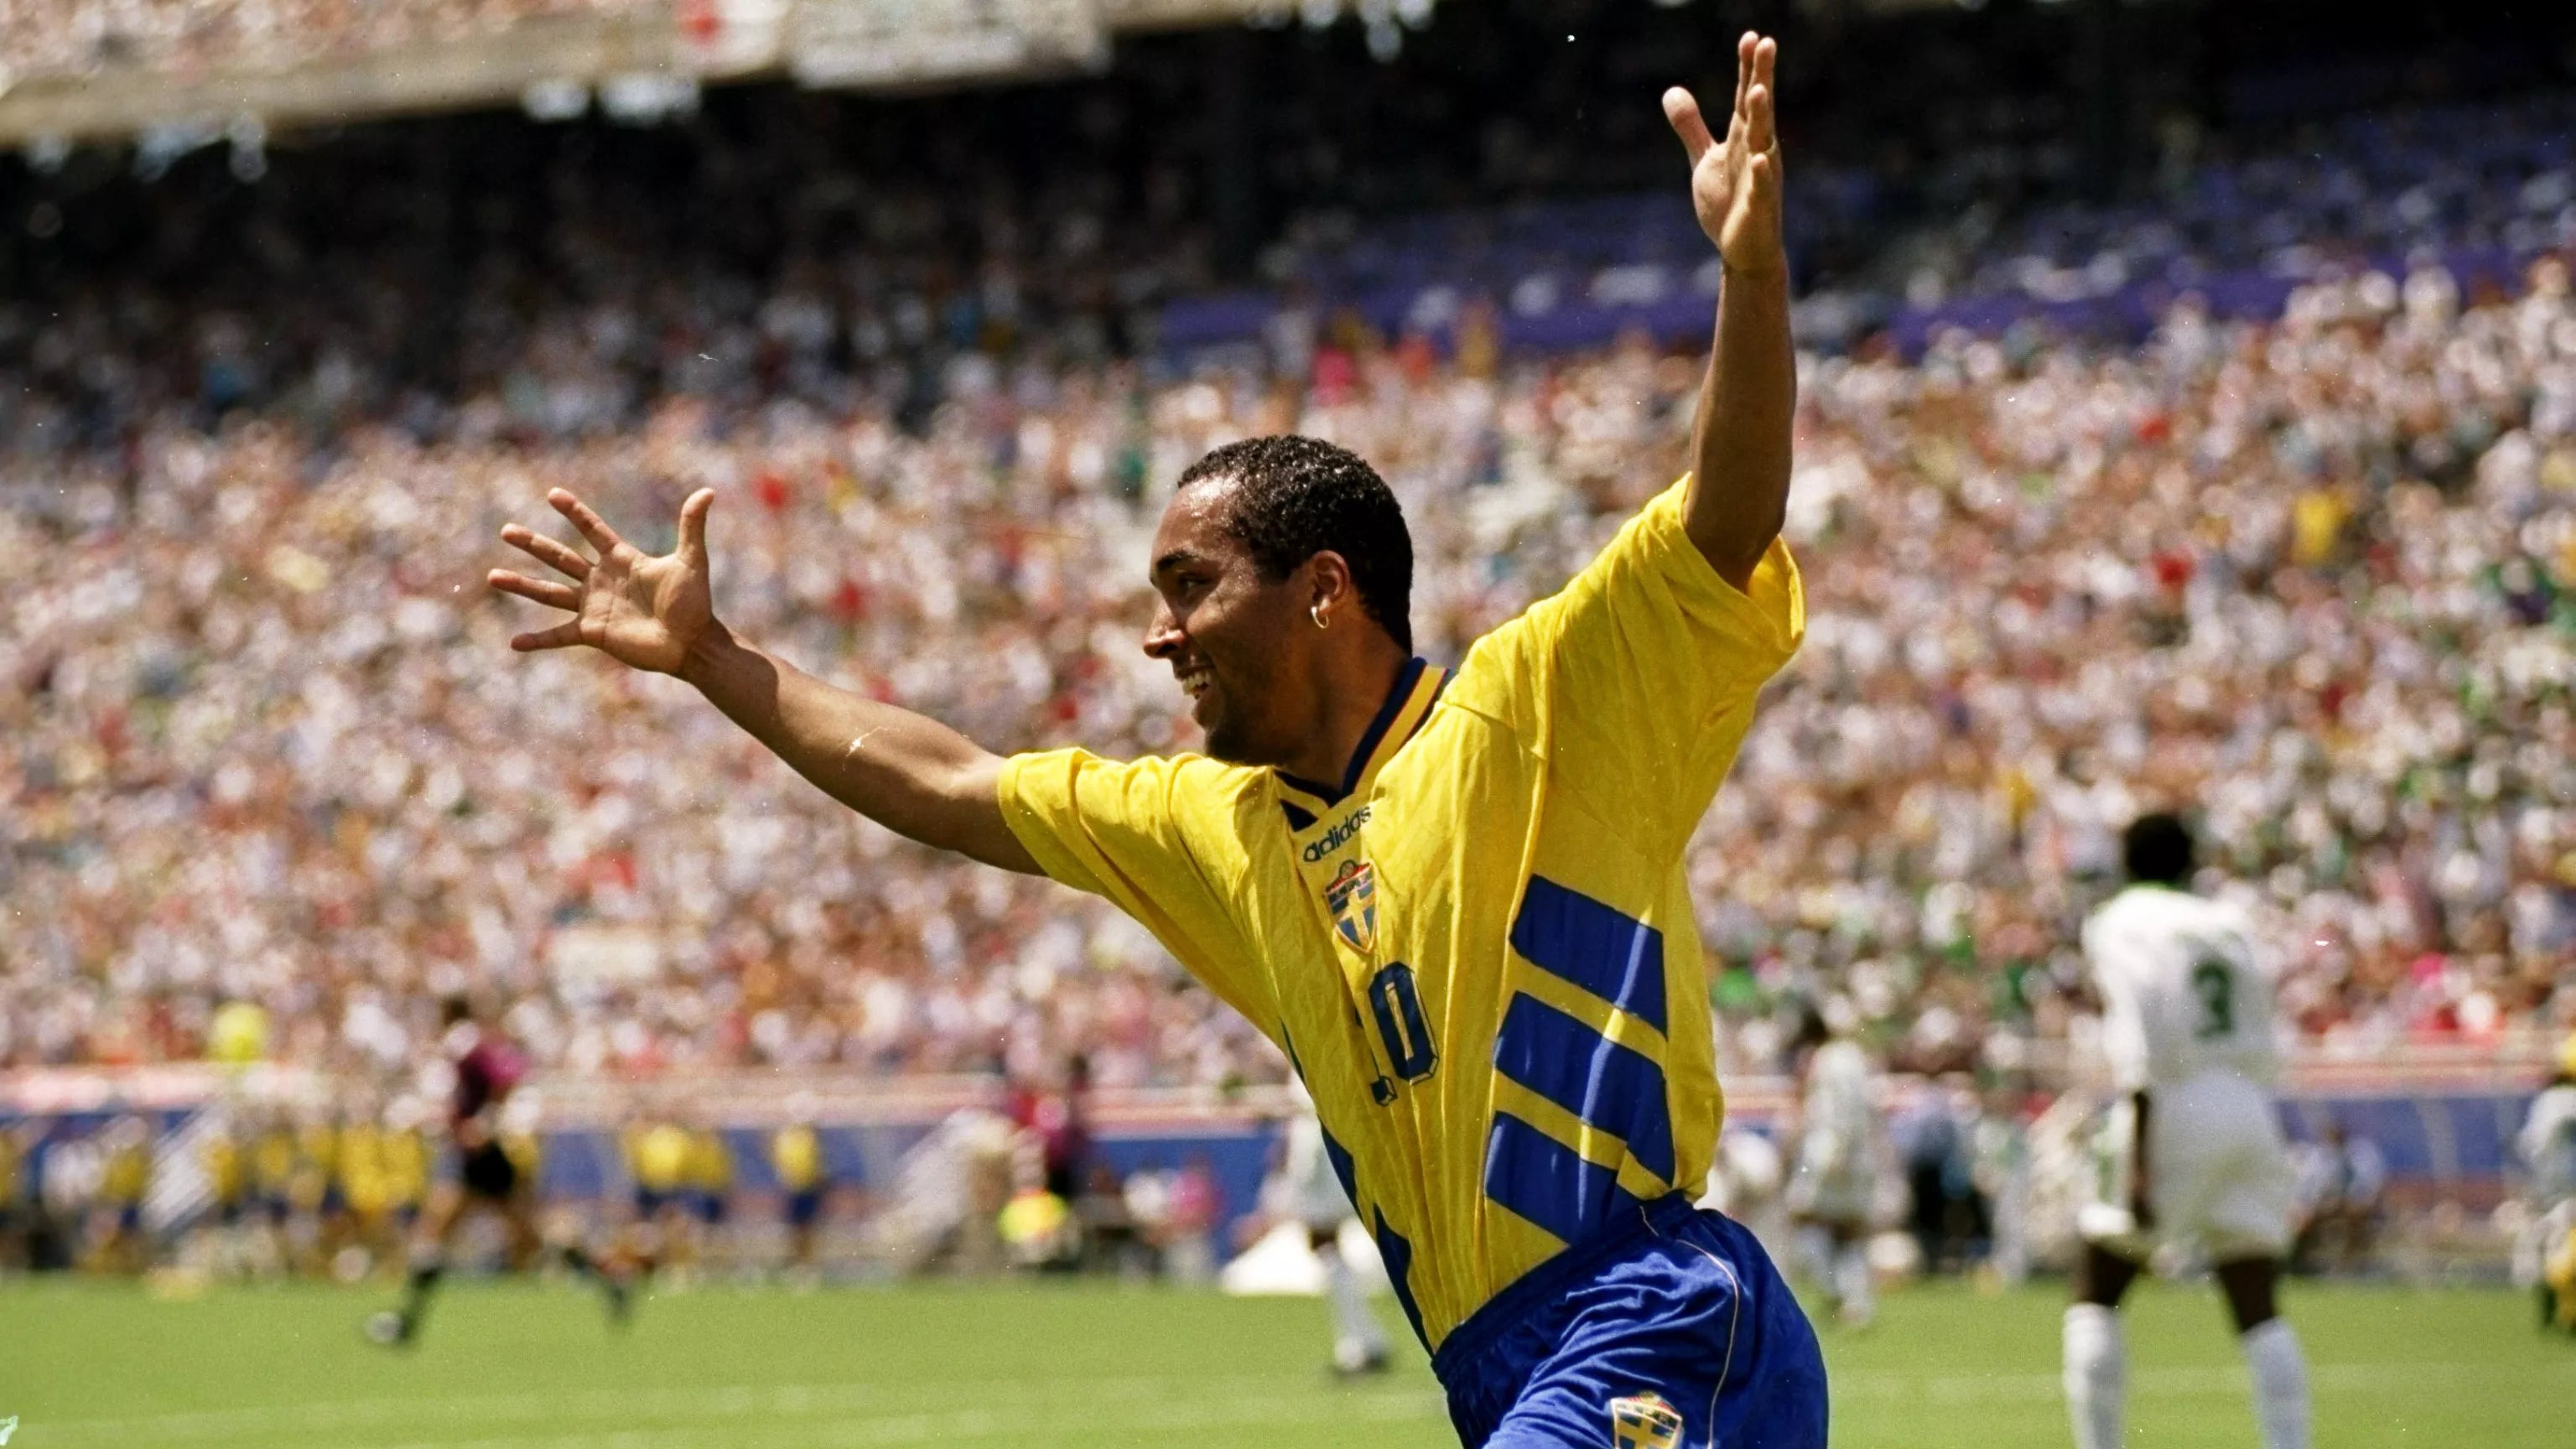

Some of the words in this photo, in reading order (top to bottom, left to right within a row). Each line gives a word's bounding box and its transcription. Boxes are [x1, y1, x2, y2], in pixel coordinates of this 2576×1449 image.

[1303, 806, 1371, 862] adidas
[1365, 961, 1439, 1107] 0
[2193, 960, 2232, 1040] 3
